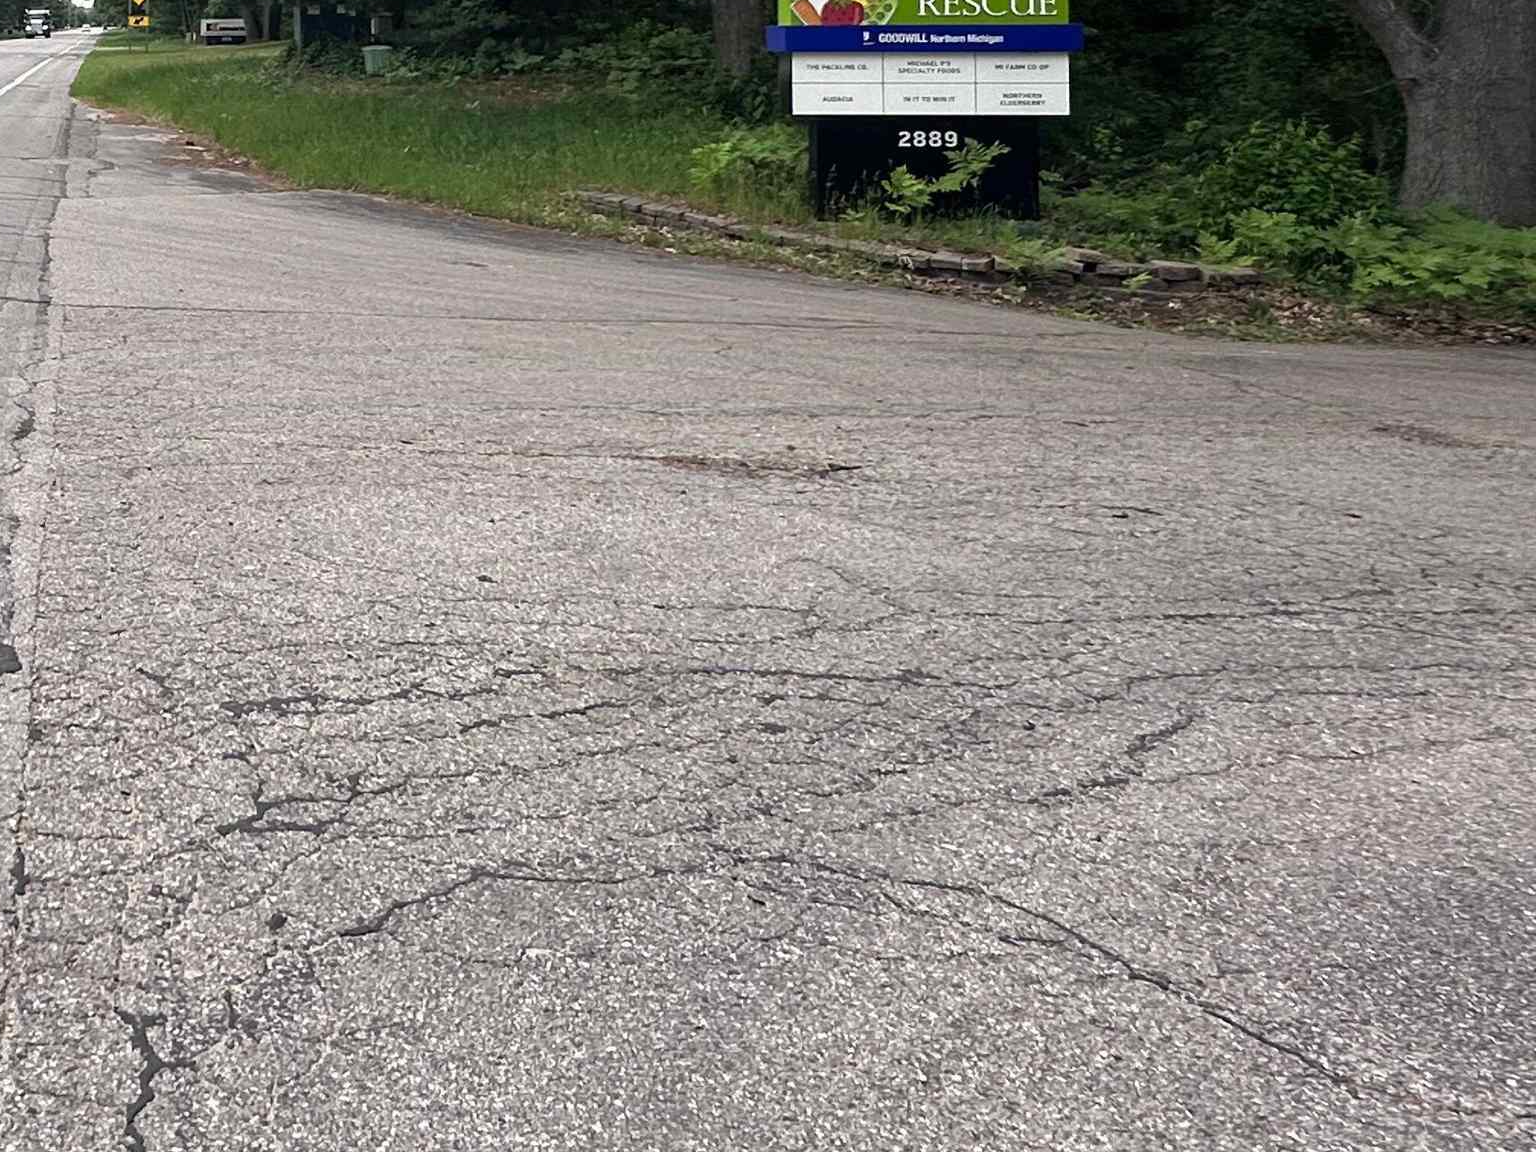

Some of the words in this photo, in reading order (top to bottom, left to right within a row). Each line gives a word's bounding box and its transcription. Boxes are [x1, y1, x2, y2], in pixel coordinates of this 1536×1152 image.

[878, 32, 928, 44] GOODWILL
[929, 33, 966, 43] Northern
[966, 33, 1004, 44] Michigan
[898, 130, 958, 148] 2889
